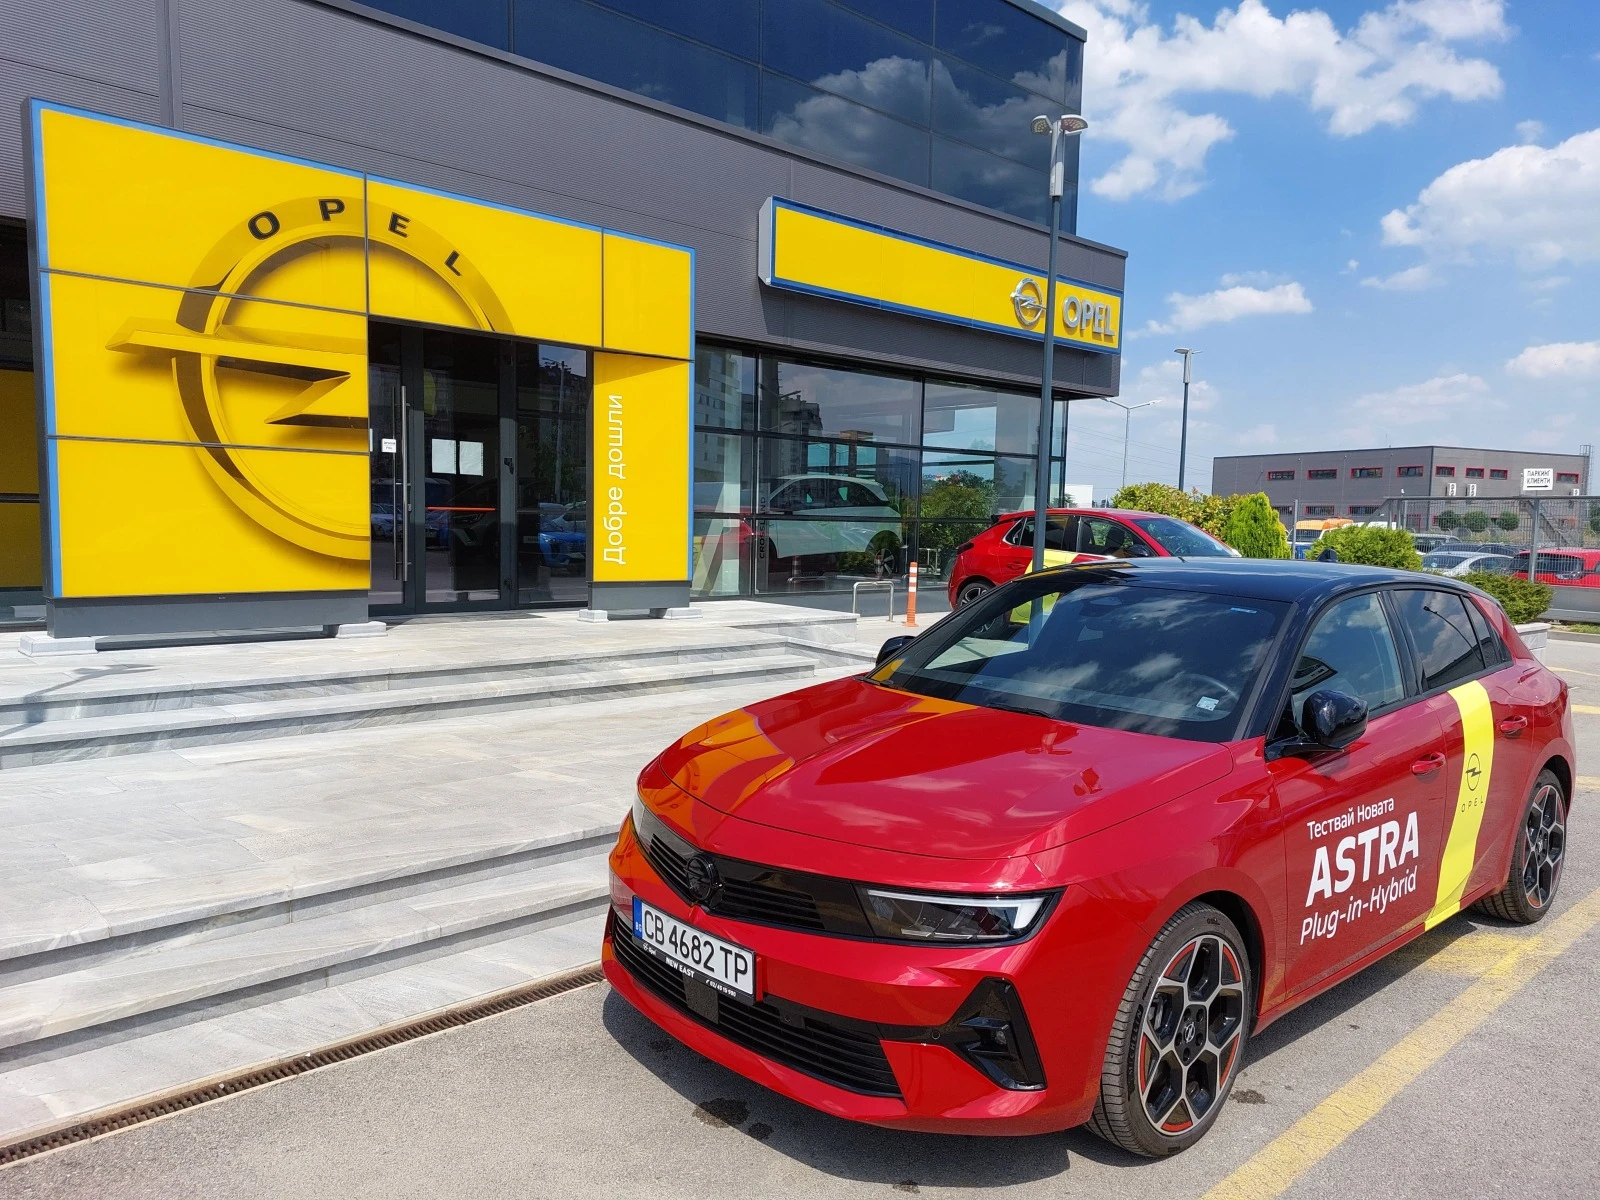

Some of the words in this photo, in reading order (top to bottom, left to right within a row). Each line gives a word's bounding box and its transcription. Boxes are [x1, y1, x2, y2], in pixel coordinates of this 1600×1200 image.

[248, 198, 463, 277] OPEL
[1063, 296, 1115, 336] OPEL
[608, 394, 626, 480] дошли
[603, 486, 627, 565] Добре
[1307, 808, 1354, 840] Тествай
[1357, 798, 1394, 823] Новата
[1461, 795, 1484, 813] OPEL
[1305, 811, 1419, 907] ASTRA
[1300, 865, 1418, 946] Plug-in-Hybrid
[665, 957, 679, 970] NEW
[679, 964, 695, 978] EAST
